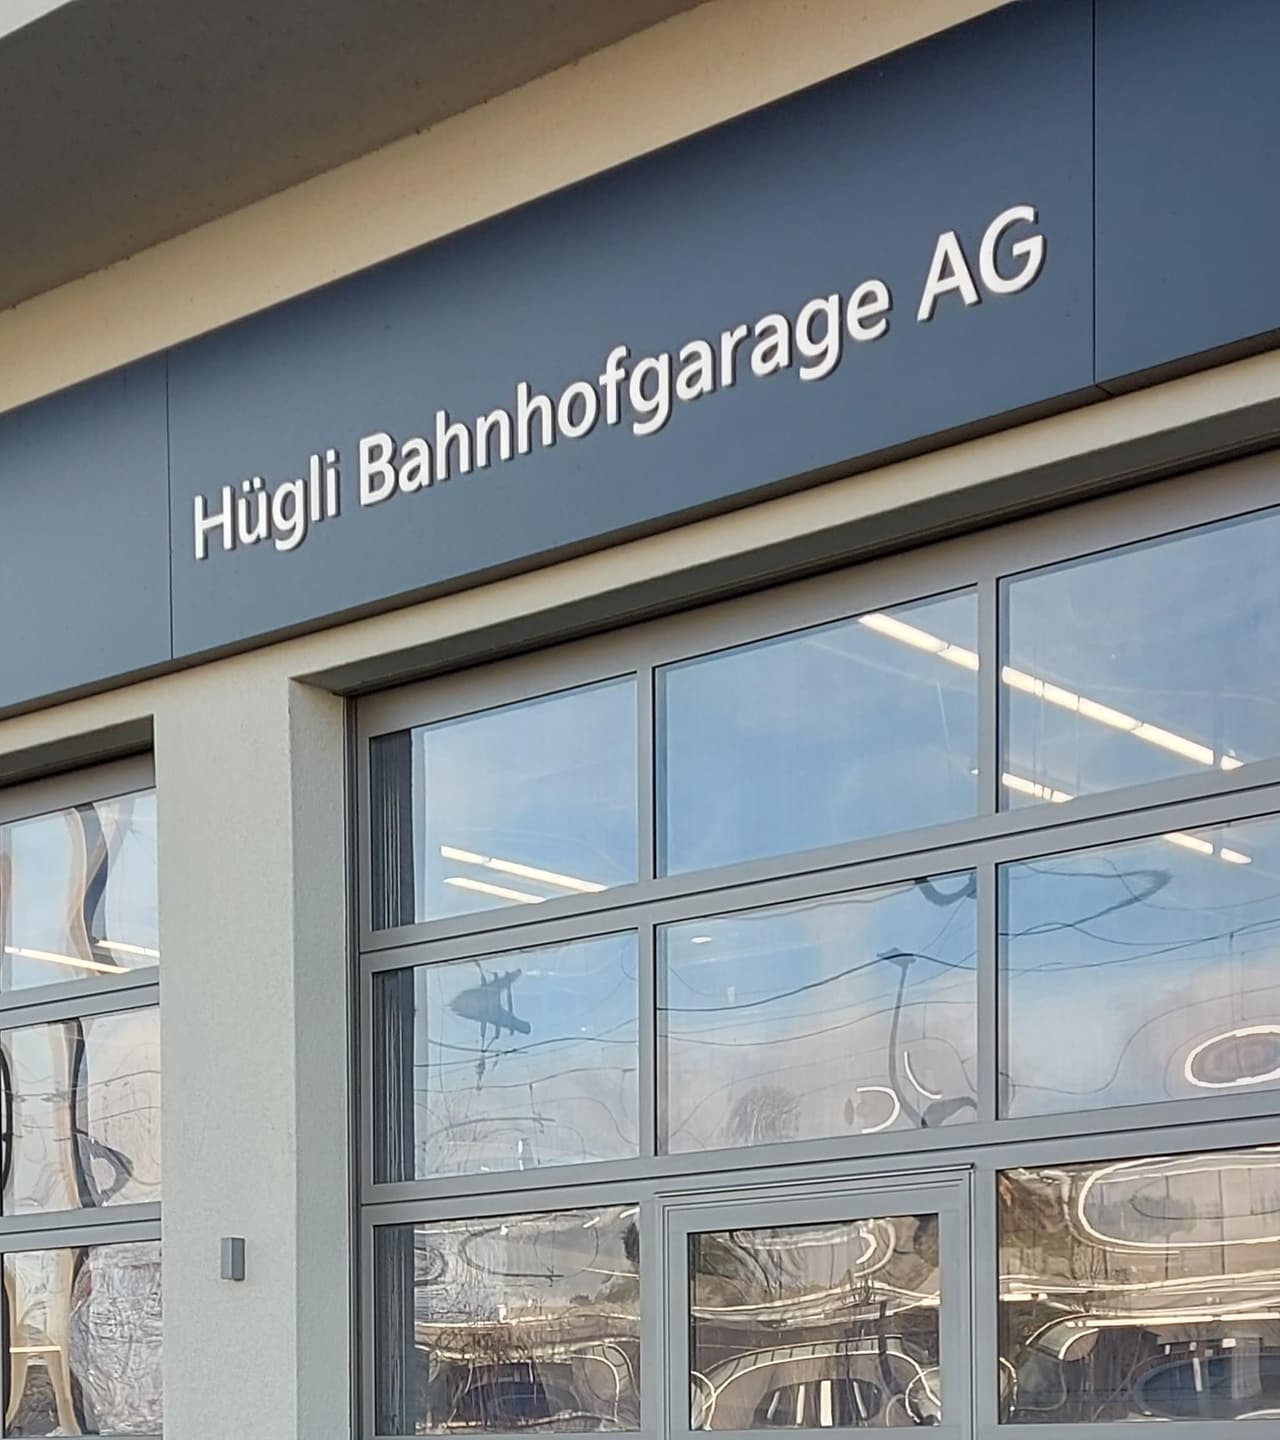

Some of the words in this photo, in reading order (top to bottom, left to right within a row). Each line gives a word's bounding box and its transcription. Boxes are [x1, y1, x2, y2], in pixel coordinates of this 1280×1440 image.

[193, 447, 340, 559] Hügli
[357, 277, 892, 508] Bahnhofgarage
[915, 204, 1048, 322] AG
